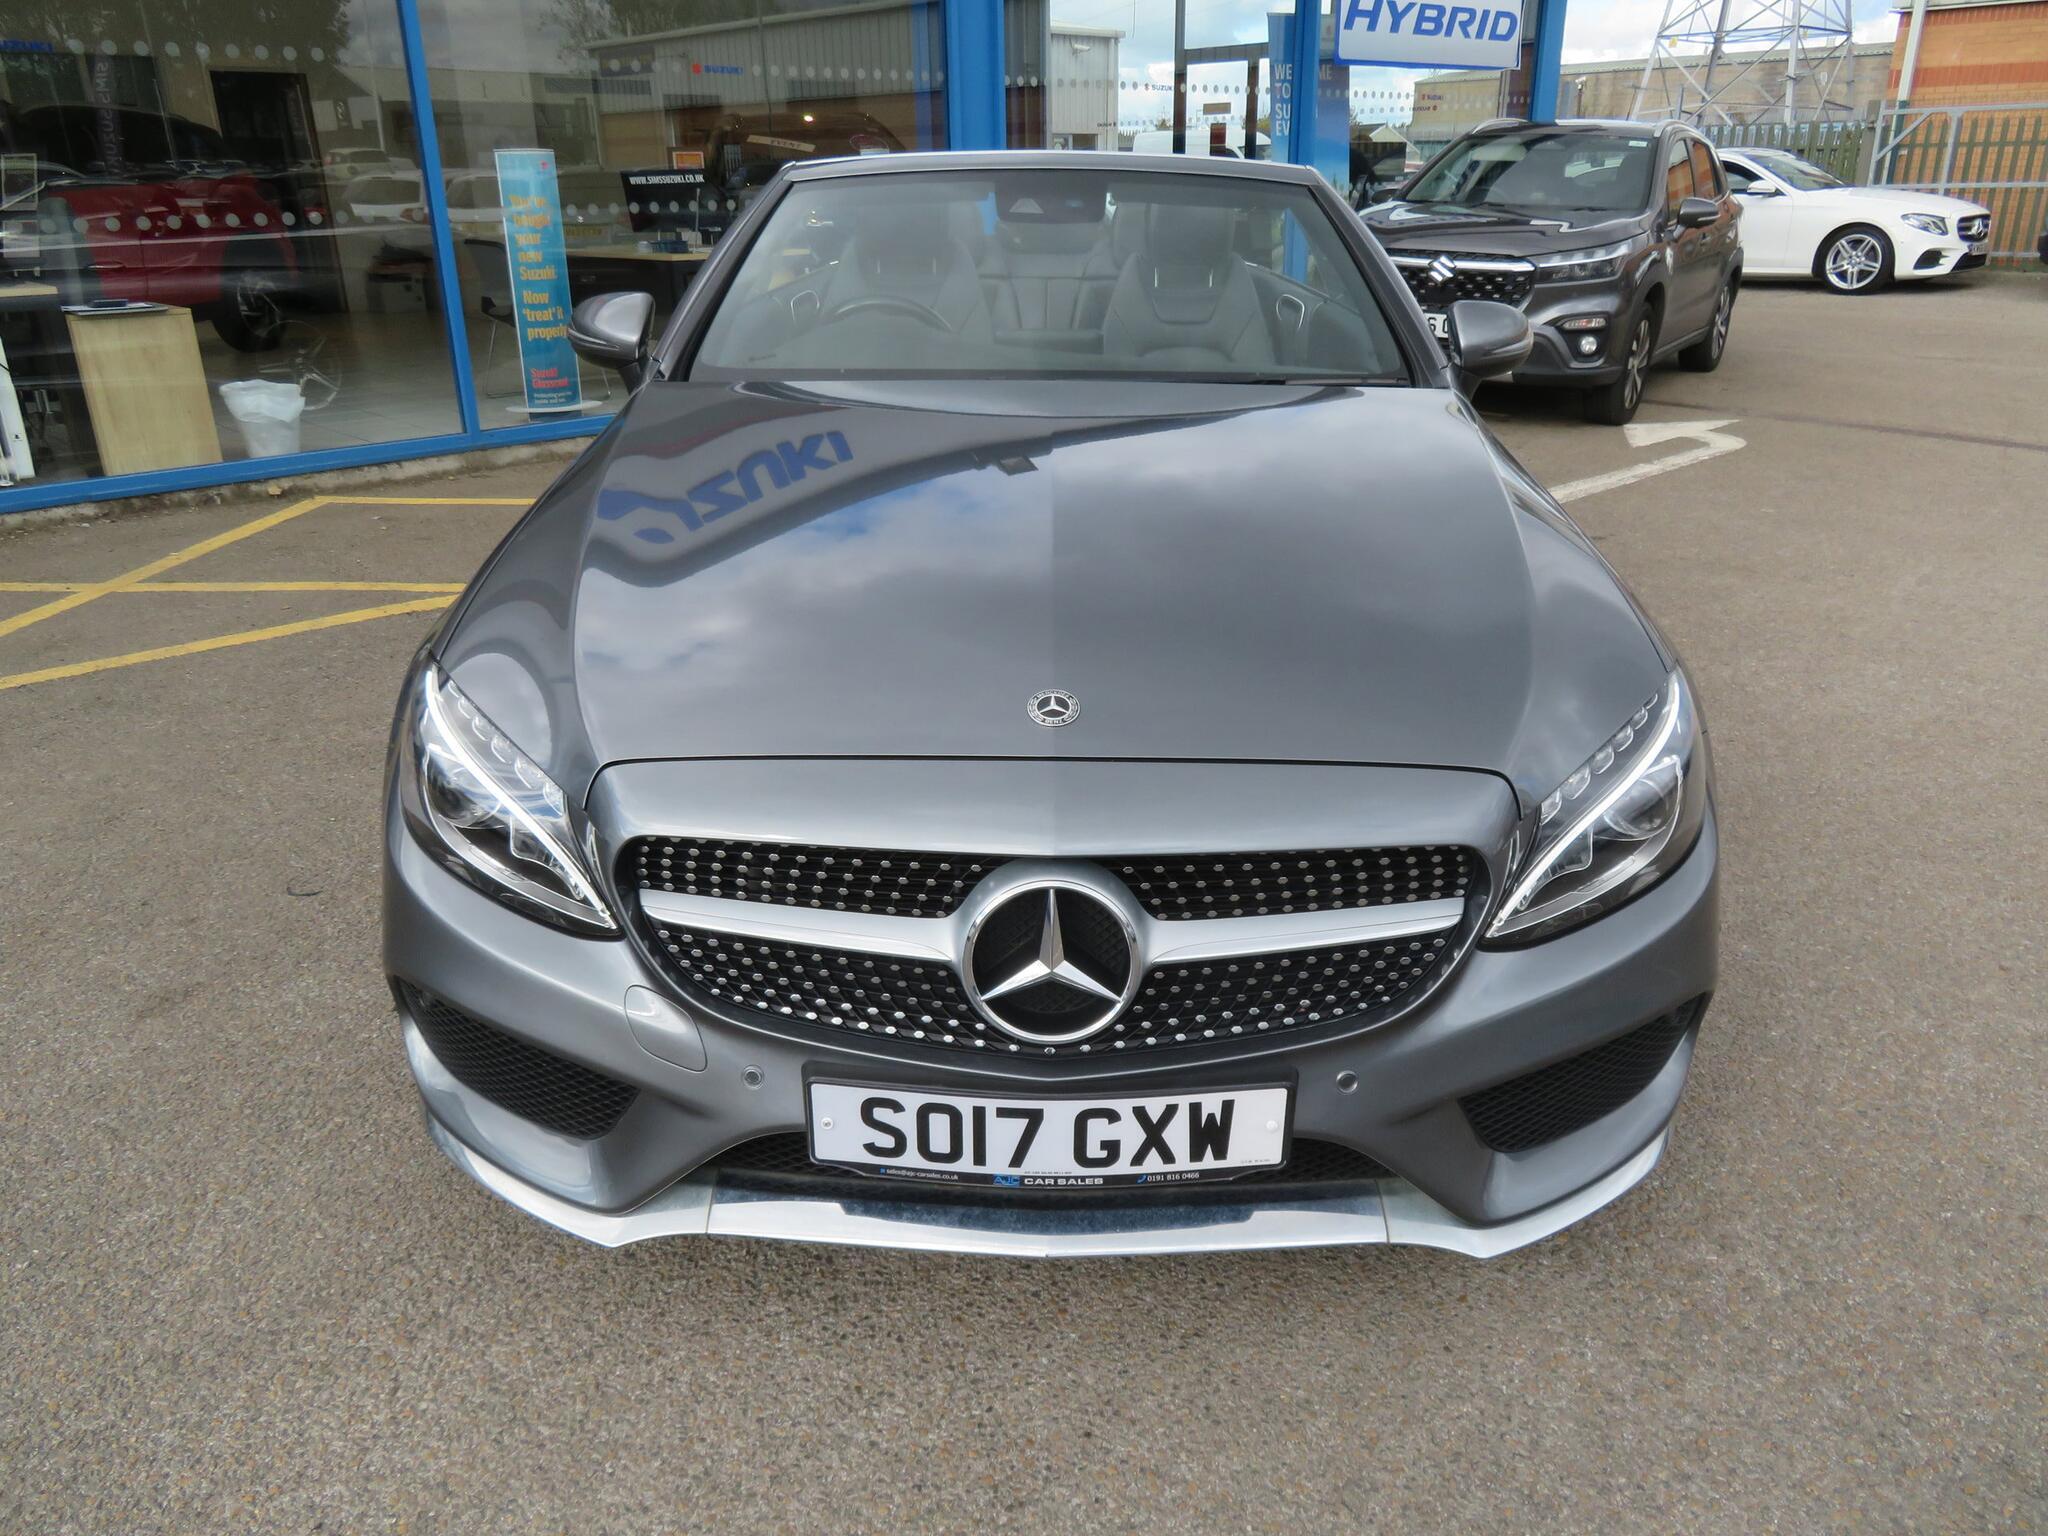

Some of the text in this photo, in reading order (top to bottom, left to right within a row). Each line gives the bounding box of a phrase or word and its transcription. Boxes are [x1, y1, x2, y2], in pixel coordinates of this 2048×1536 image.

[1343, 0, 1518, 42] HYBRID
[704, 64, 745, 75] SUZUKI
[1151, 83, 1173, 91] SUZUK
[1274, 82, 1291, 99] TO
[523, 290, 549, 304] Now
[860, 1097, 1235, 1169] SO17 GXW
[1147, 1172, 1200, 1182] 0191 816 0466
